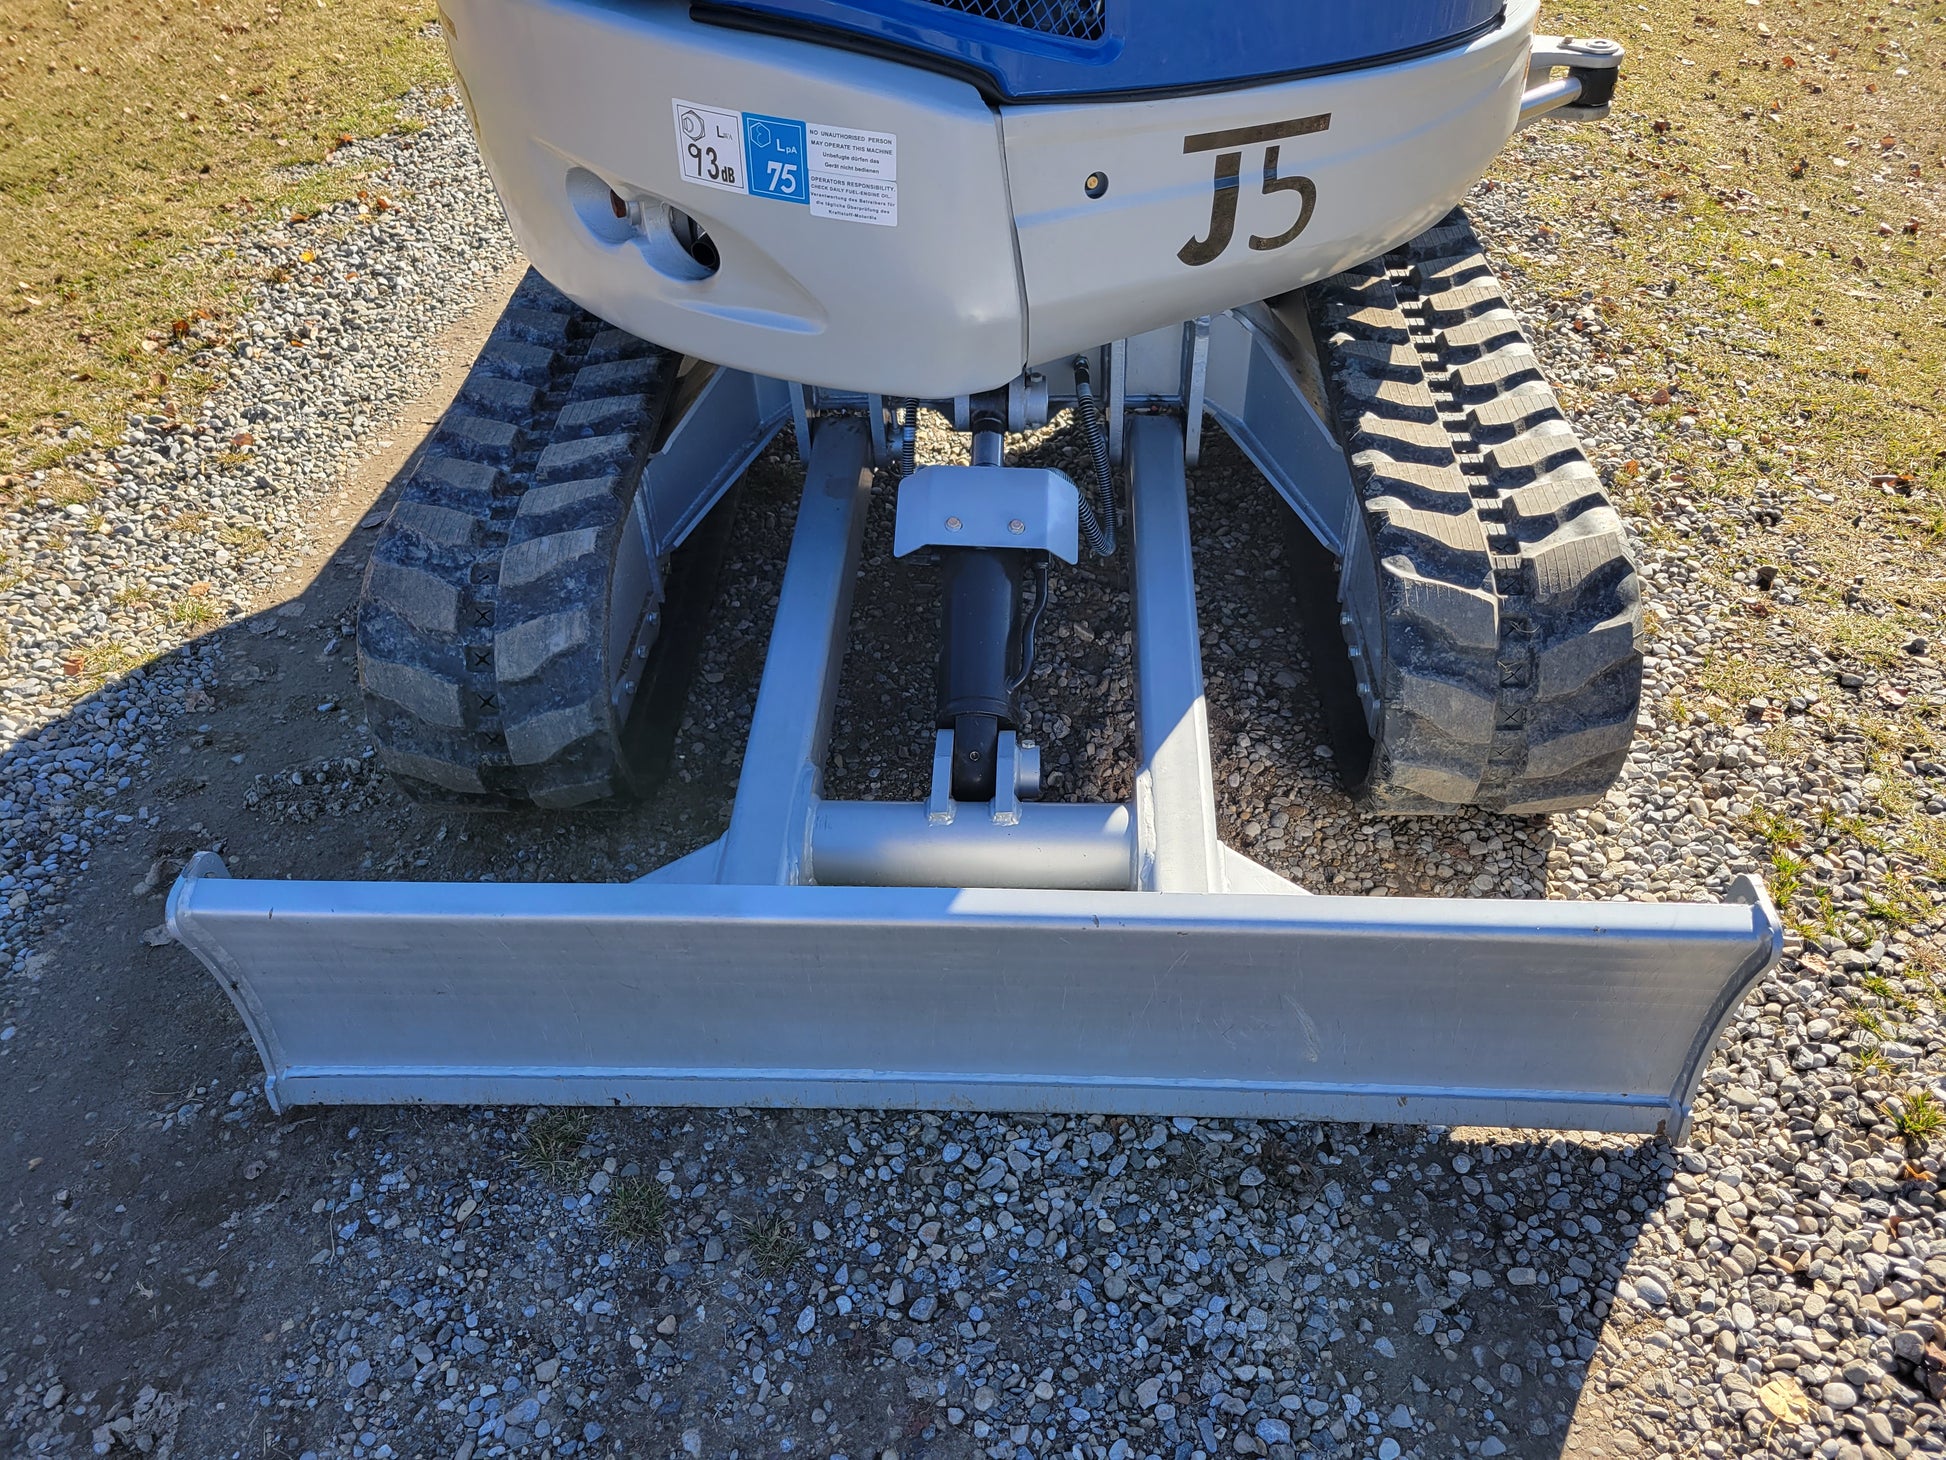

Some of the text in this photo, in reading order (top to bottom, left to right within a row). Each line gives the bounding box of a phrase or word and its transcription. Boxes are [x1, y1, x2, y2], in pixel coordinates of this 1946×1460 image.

[821, 131, 865, 141] UNAUTHORISED
[868, 137, 892, 145] PERSON
[776, 139, 798, 154] LpA
[824, 142, 851, 150] OPERATE
[823, 152, 850, 160] Unbefugte
[767, 160, 797, 194] 75
[811, 176, 846, 186] OPERATORS
[1177, 113, 1331, 266] J5
